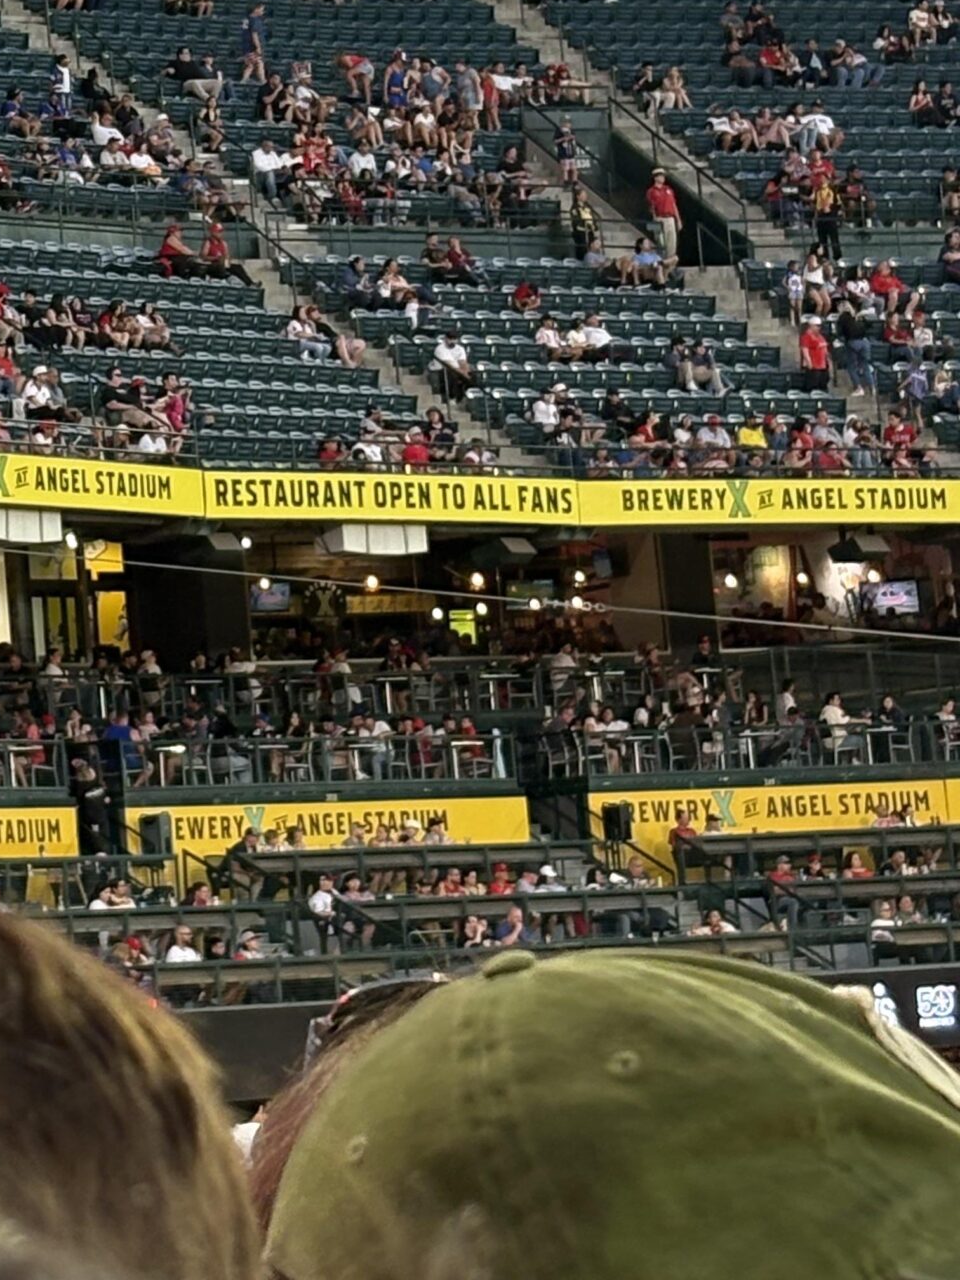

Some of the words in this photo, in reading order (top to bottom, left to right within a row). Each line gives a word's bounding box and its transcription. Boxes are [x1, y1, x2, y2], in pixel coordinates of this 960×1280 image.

[15, 468, 28, 486] AT
[34, 466, 90, 493] ANGEL
[96, 470, 172, 500] STADIUM
[214, 478, 365, 508] RESTAURANT
[373, 481, 432, 509] OPEN
[438, 483, 466, 510] TO
[473, 484, 511, 511] ALL
[517, 485, 572, 514] FANS
[758, 490, 773, 508] AT
[781, 487, 848, 510] ANGEL
[854, 487, 948, 510] STADIUM
[743, 801, 759, 819] AT
[766, 794, 832, 818] ANGEL
[838, 790, 930, 816] STADIUM
[296, 813, 353, 837] ANGEL
